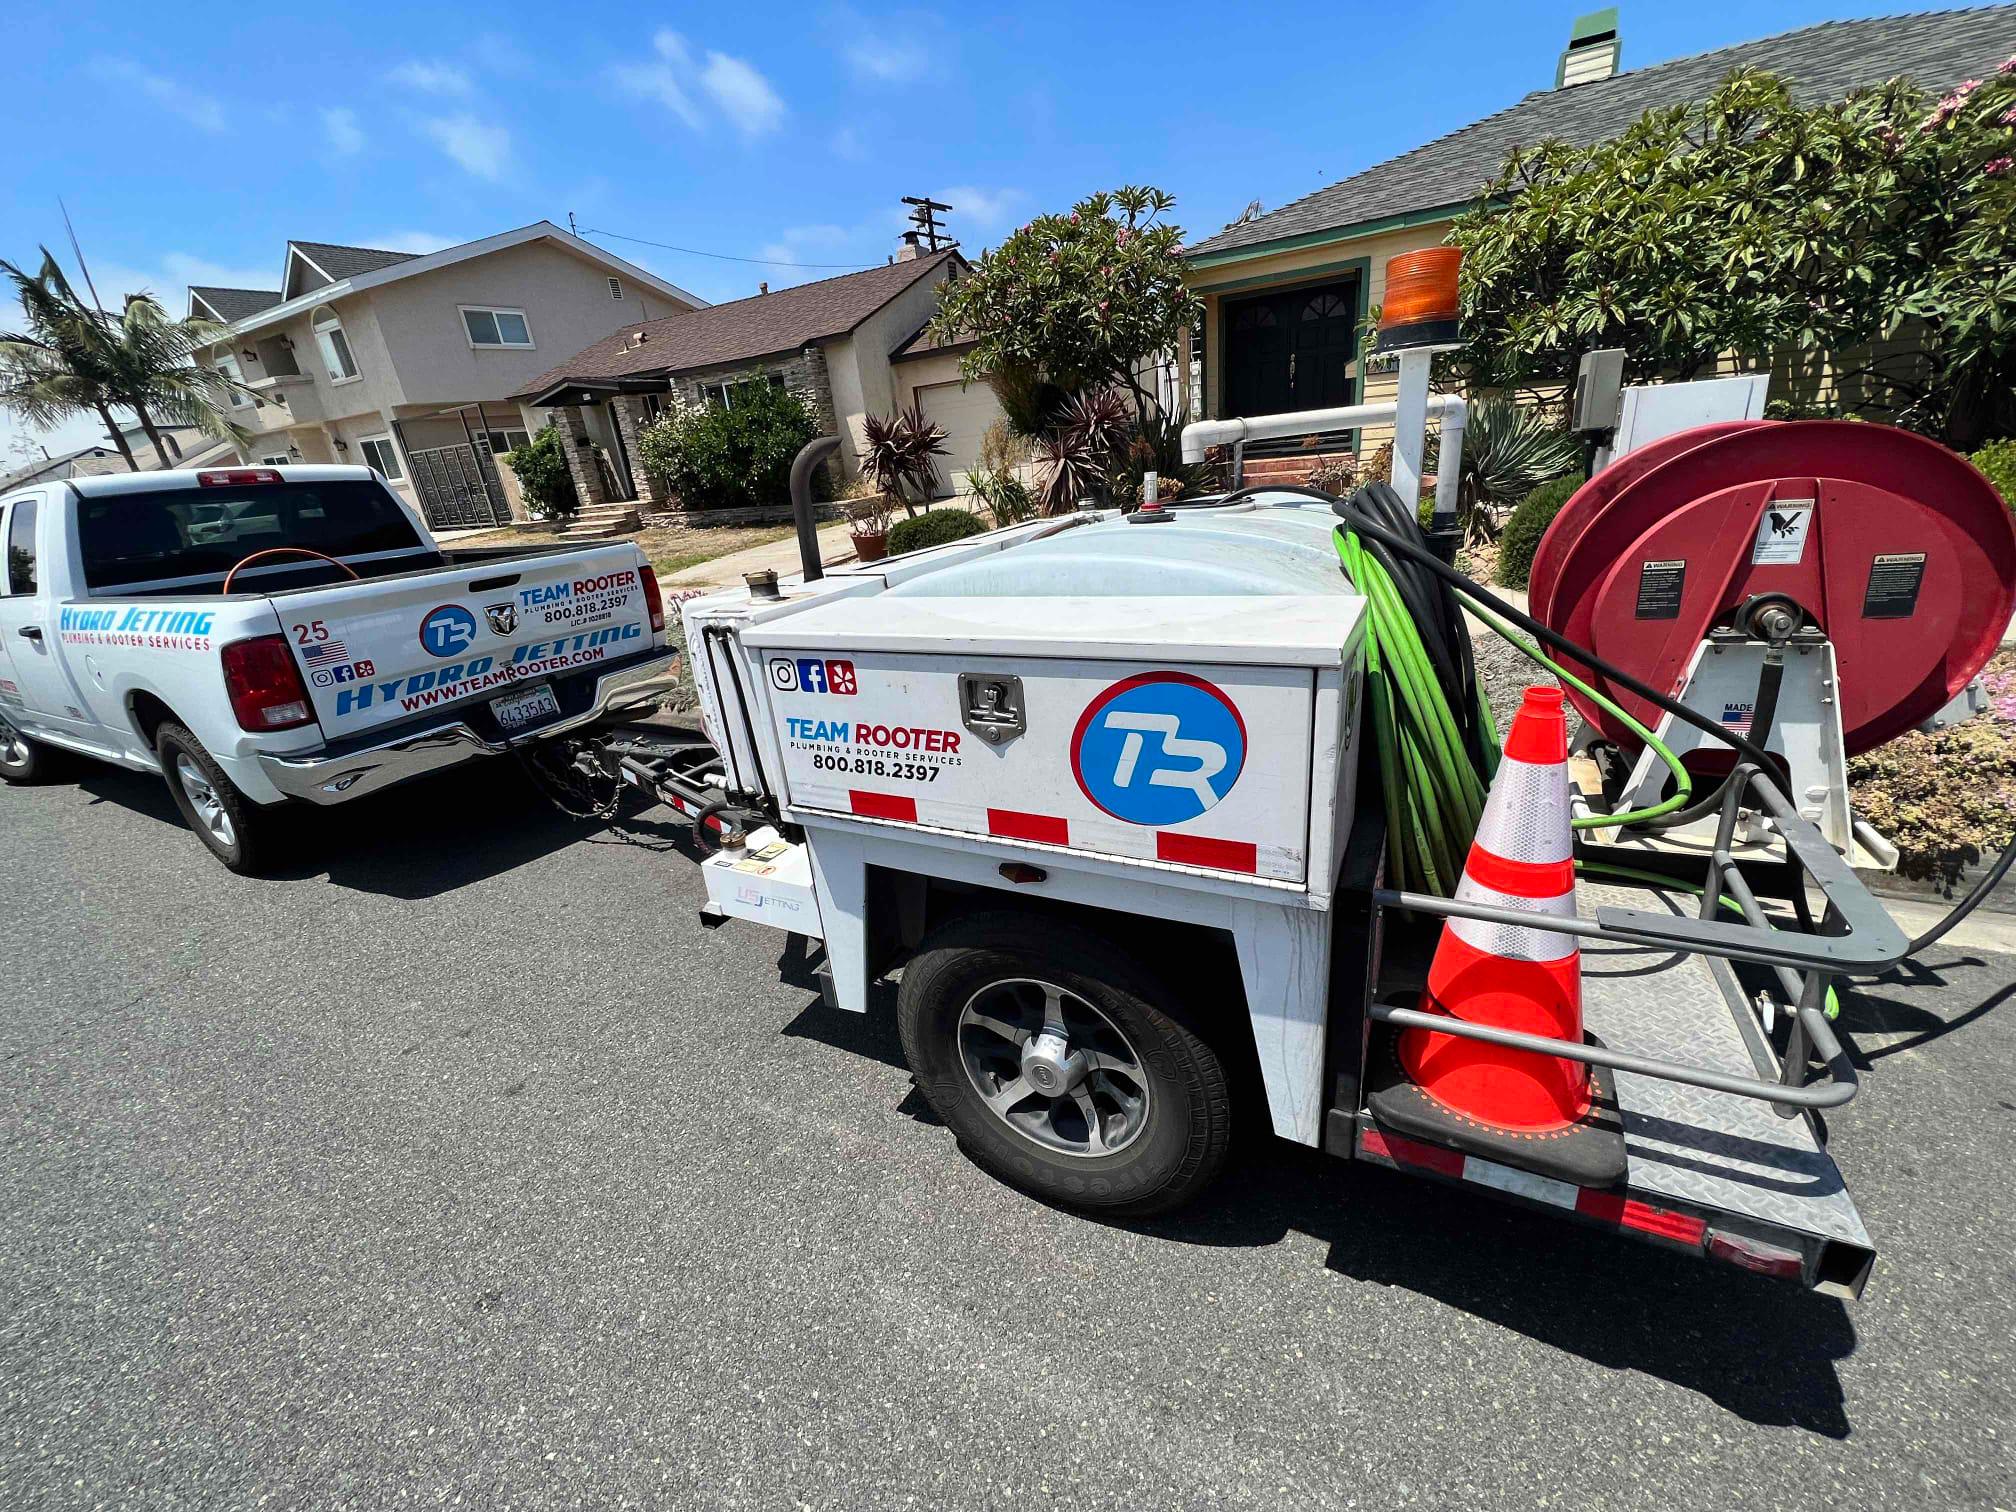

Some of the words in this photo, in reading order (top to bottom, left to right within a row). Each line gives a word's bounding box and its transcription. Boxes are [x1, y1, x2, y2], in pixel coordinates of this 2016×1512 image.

[519, 582, 570, 606] TEAM
[573, 570, 635, 596] ROOTER
[524, 602, 565, 615] PLUMBING
[576, 594, 604, 604] ROOTER
[607, 585, 638, 597] SERVICES
[60, 607, 117, 631] HYDRO
[116, 607, 216, 635] JETTING
[544, 595, 628, 623] 800.818.2397
[106, 634, 144, 647] ROOTER
[149, 636, 210, 651] SERVICES
[292, 620, 329, 645] 25
[336, 656, 494, 716] HYDRO
[511, 622, 641, 664] JETTING
[400, 647, 605, 712] WWW.TEAMROOTER.COM
[1724, 703, 1753, 712] MADE
[786, 717, 849, 743] TEAM
[855, 723, 961, 754] ROOTER
[790, 742, 840, 754] PLUMBING
[857, 748, 899, 760] ROOTER
[905, 753, 962, 766] SERVICES
[813, 754, 940, 783] 800.818.2397
